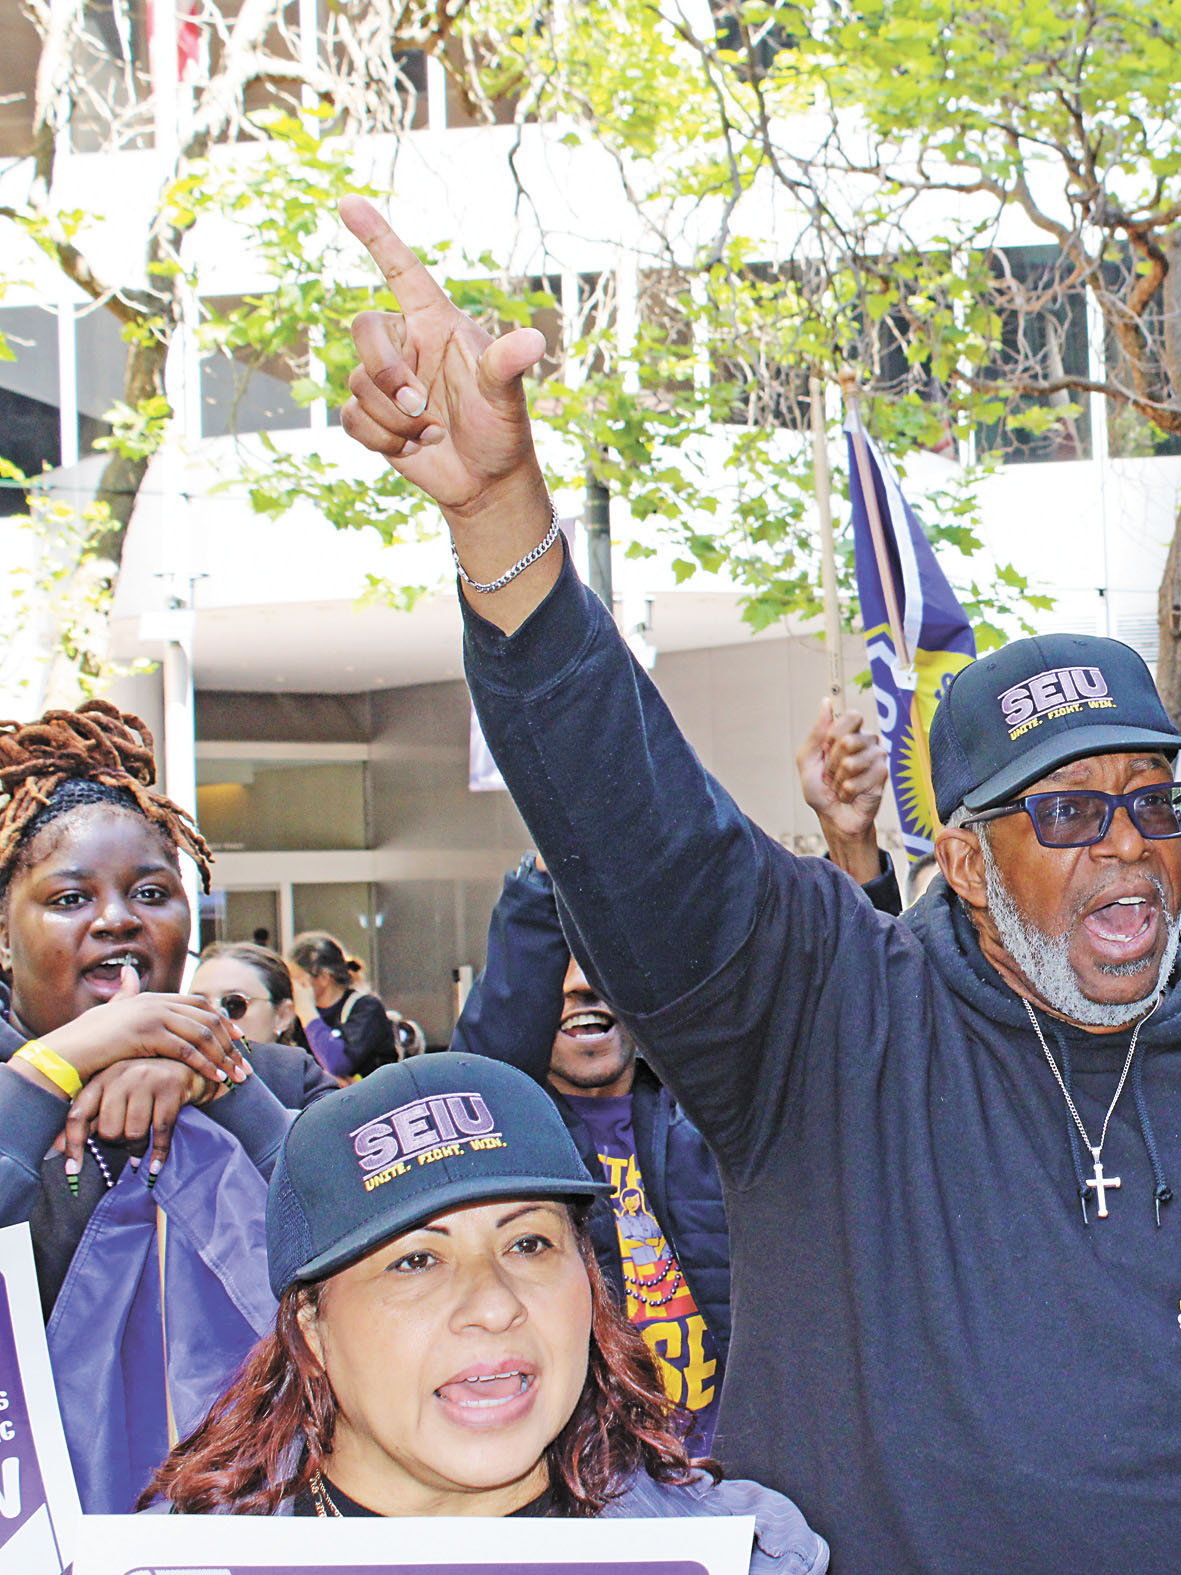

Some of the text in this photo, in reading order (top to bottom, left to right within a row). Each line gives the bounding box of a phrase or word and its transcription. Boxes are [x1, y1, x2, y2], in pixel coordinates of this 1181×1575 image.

[1001, 669, 1109, 725] SEIU
[1010, 700, 1117, 741] UNITE. FIGHT. WIN.
[354, 1096, 494, 1171] SEIU
[363, 1137, 508, 1192] UNITE. FIGHT. WIN.
